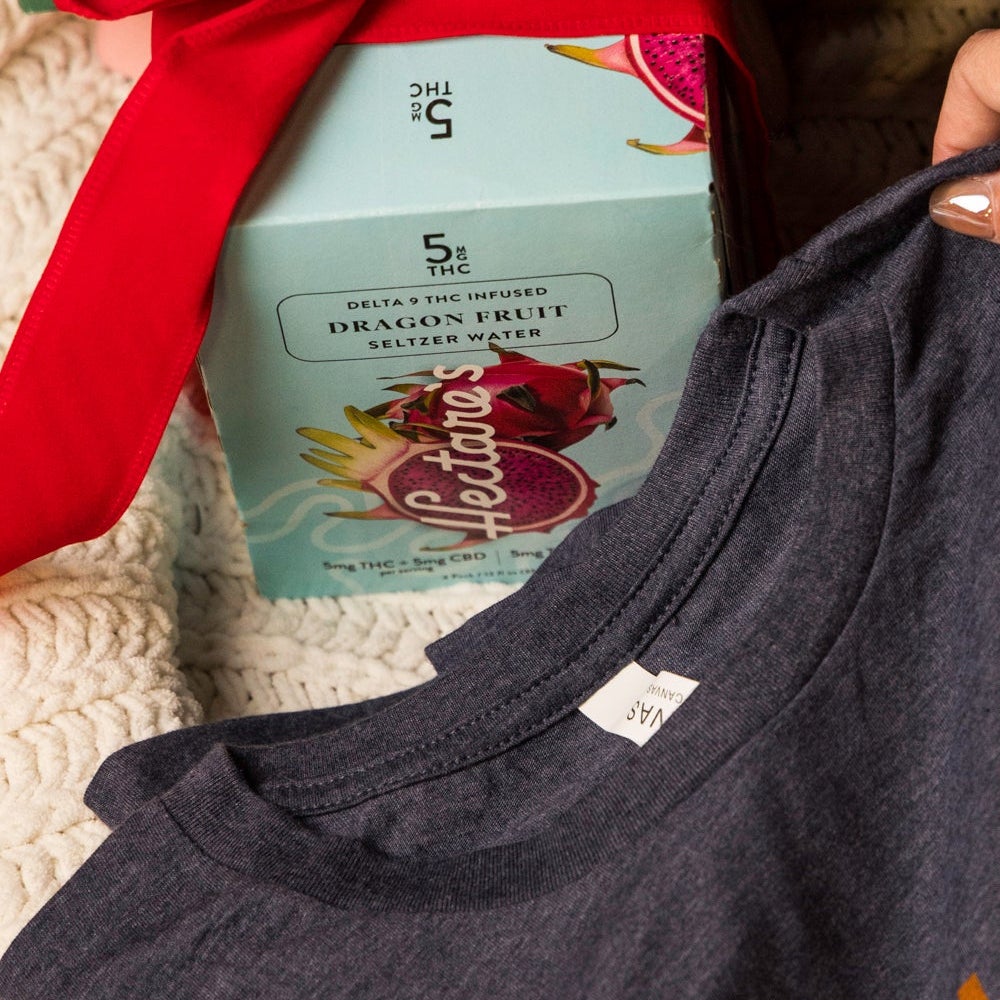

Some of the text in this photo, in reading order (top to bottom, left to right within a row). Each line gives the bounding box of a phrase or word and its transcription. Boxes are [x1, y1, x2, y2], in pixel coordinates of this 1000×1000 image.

[409, 81, 453, 98] THC
[425, 98, 453, 140] 5
[422, 233, 453, 264] 5
[426, 263, 471, 277] THC
[347, 287, 548, 310] DELTA 9 THC INFUSED
[328, 304, 568, 334] DRAGON FRUIT
[368, 328, 542, 350] SELTZER WATER
[404, 364, 513, 540] Hectare's
[360, 560, 394, 570] THC
[450, 551, 487, 563] CBD
